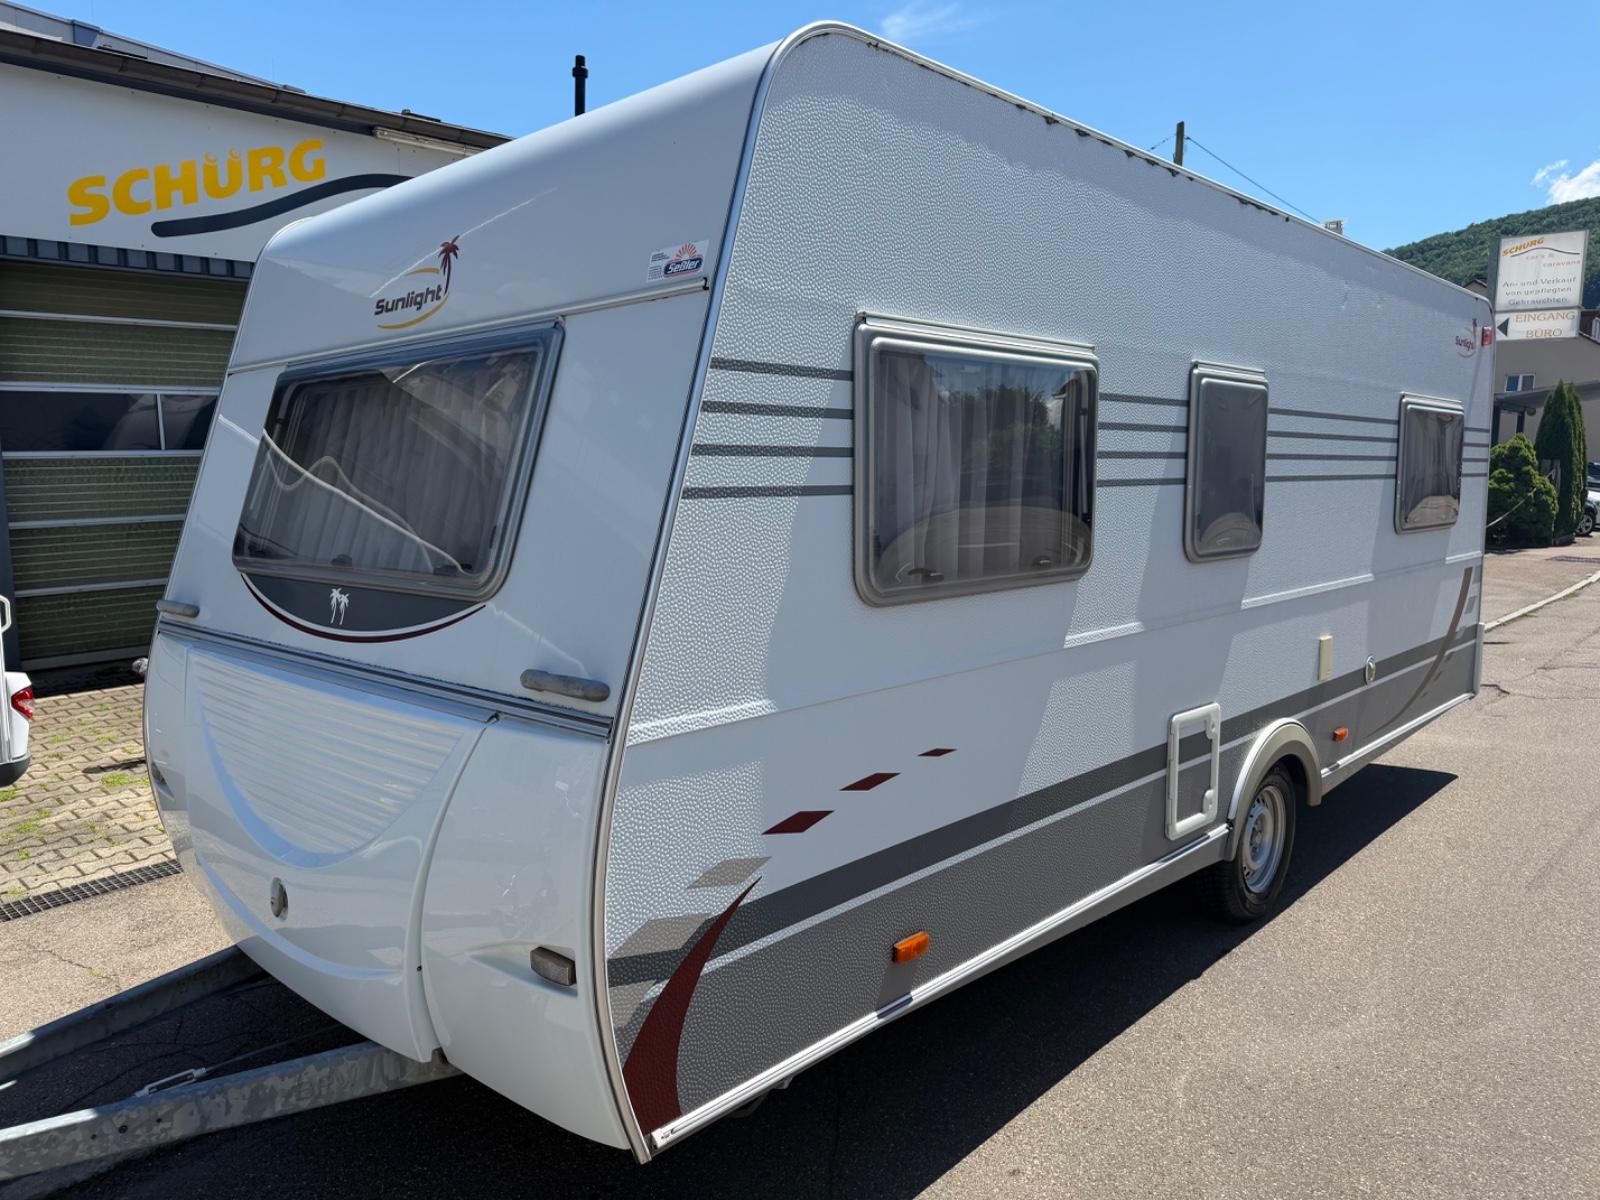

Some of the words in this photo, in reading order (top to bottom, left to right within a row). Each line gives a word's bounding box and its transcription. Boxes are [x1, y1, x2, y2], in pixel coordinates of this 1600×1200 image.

[66, 138, 327, 226] SCHÜRG
[1520, 279, 1538, 287] und
[1540, 276, 1577, 285] Verkauf
[1524, 286, 1572, 297] gepflegten
[373, 283, 443, 316] Sunlight
[1514, 310, 1576, 323] EINGANG
